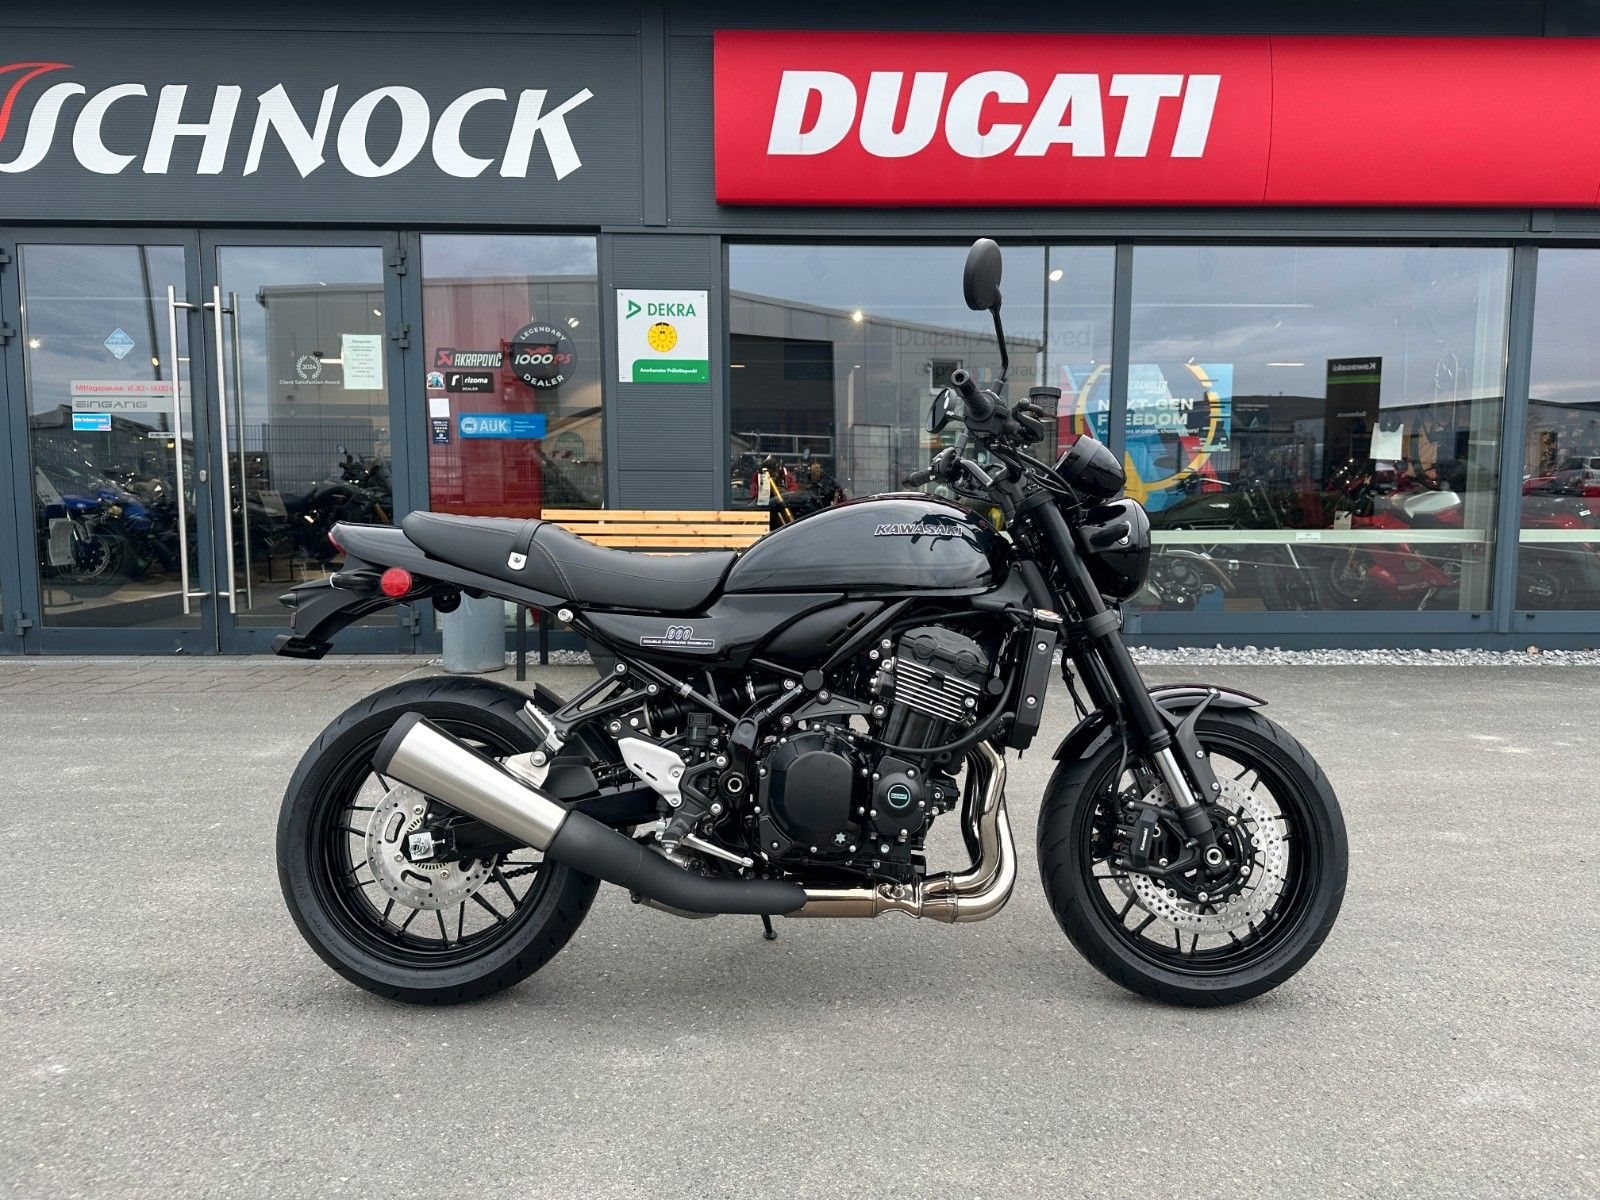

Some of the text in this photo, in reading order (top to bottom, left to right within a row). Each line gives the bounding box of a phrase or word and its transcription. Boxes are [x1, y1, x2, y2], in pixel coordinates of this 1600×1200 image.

[767, 70, 1222, 158] DUCATI
[0, 82, 594, 181] SCHNOCK
[647, 302, 696, 317] DEKRA
[520, 326, 567, 341] LEGENDARY
[464, 375, 488, 384] rizoma
[523, 373, 565, 387] DEALER
[1097, 399, 1194, 410] NXT-GEN
[479, 420, 507, 432] AUK
[1097, 413, 1188, 426] FEEDOM
[874, 523, 963, 537] KAWASAKI
[667, 628, 691, 640] 900
